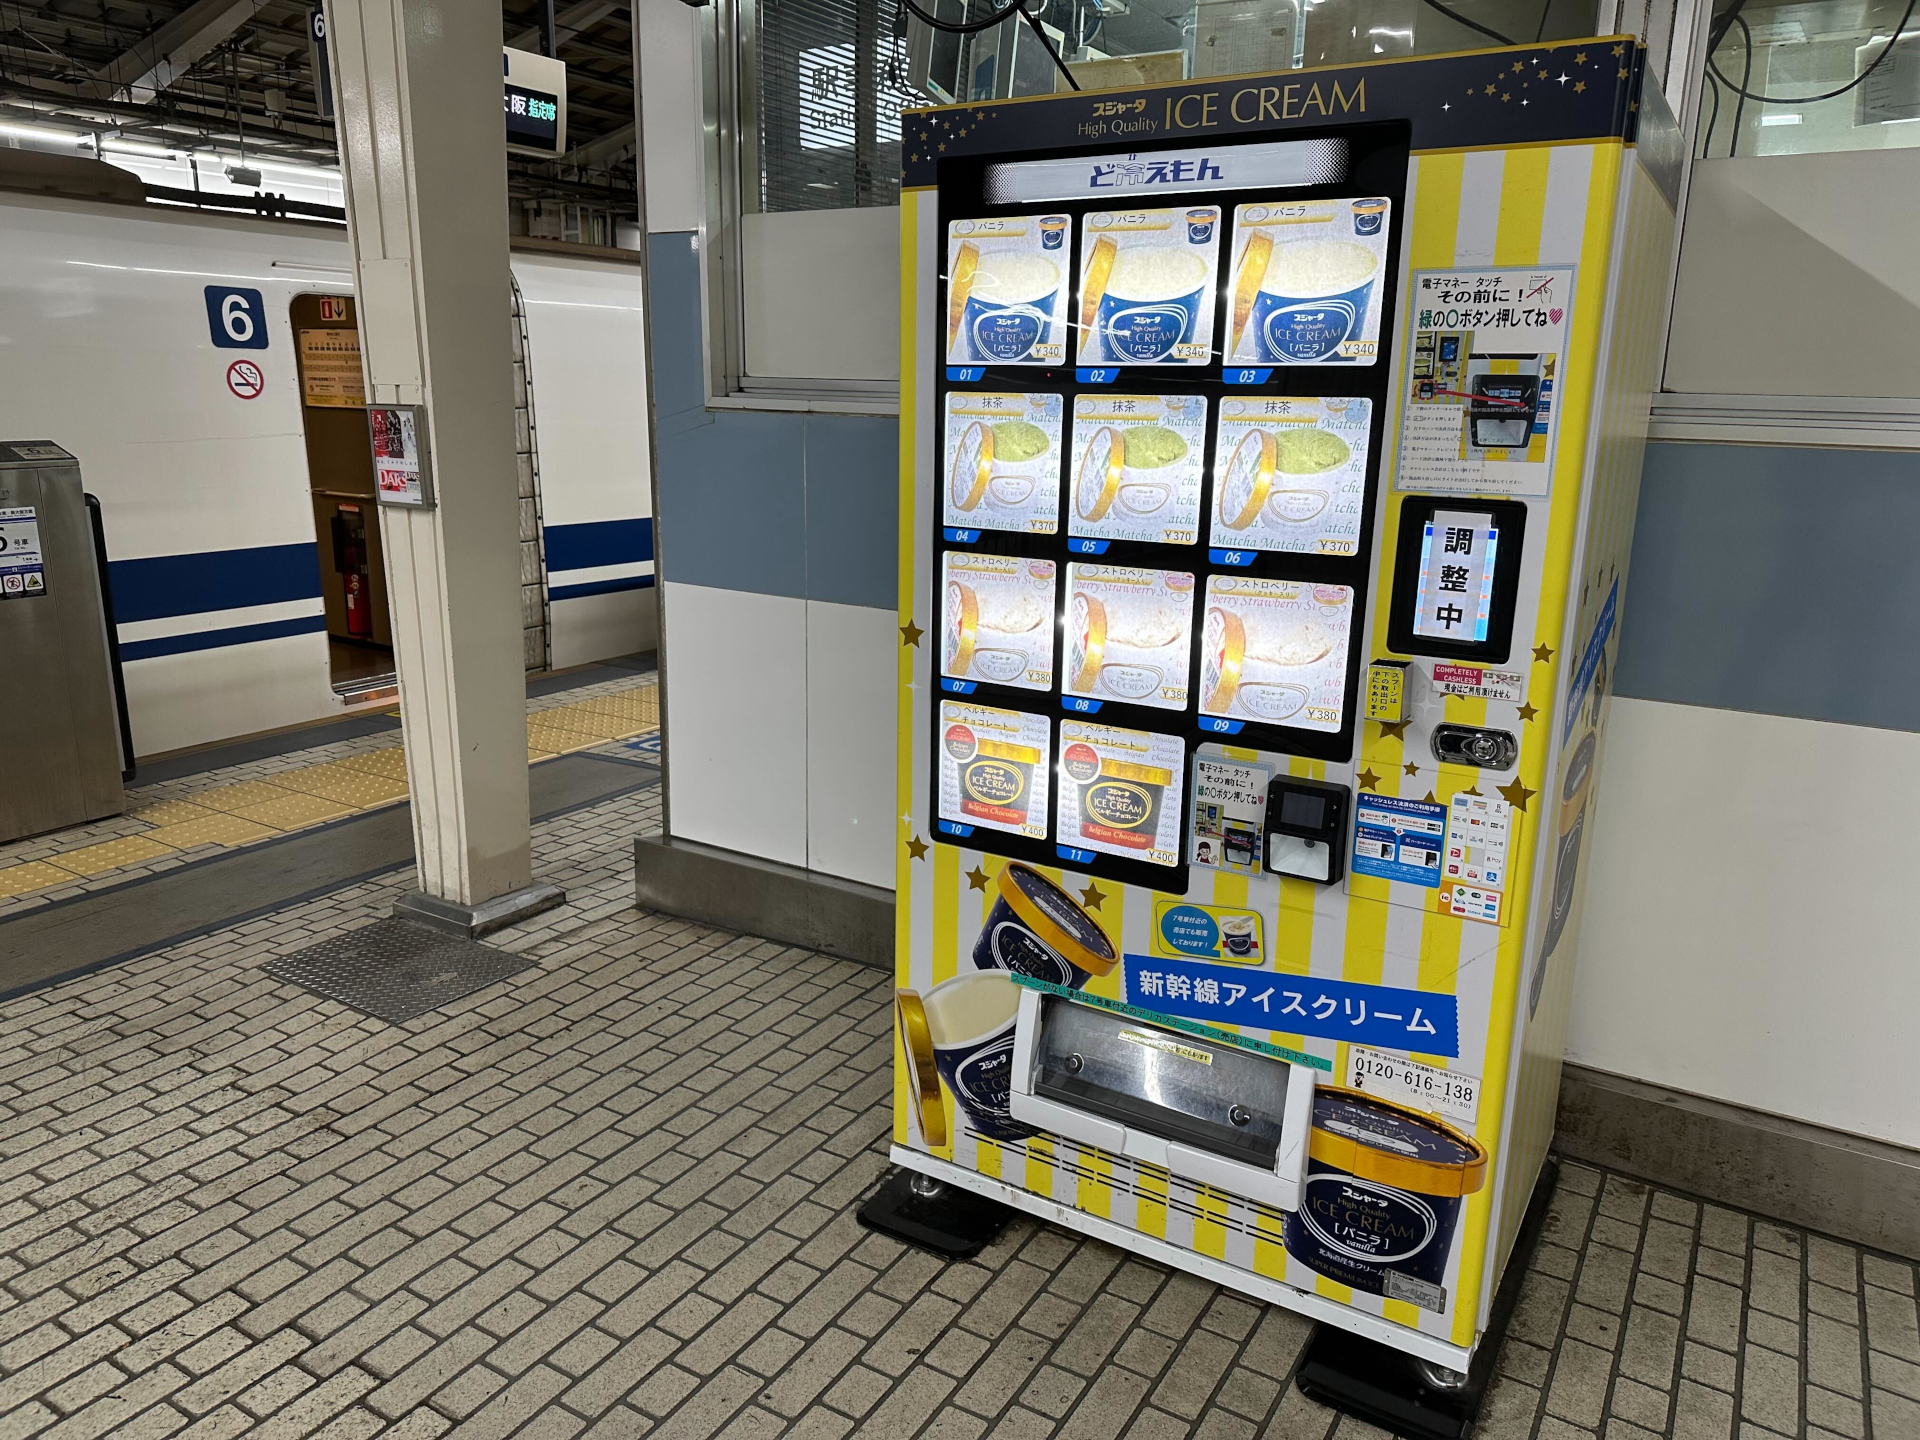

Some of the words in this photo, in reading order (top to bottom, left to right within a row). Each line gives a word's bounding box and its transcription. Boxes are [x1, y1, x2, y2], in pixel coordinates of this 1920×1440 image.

[314, 14, 326, 38] 6
[504, 94, 526, 116] 阪
[528, 98, 556, 122] 指定席
[1078, 123, 1106, 138] High
[1112, 117, 1158, 136] Quality
[1164, 93, 1218, 130] ICE
[1230, 77, 1366, 124] CREAM
[1093, 99, 1146, 116] スジャータ
[1274, 206, 1306, 216] バニラ
[979, 221, 1005, 230] バニラ
[1118, 215, 1147, 224] バニラ
[1422, 278, 1470, 289] 電子マネー
[1476, 276, 1502, 288] タッチ
[222, 294, 254, 342] 6
[996, 318, 1021, 326] スジャータ
[1134, 316, 1161, 324] スジャータ
[1293, 313, 1325, 322] スジャータ
[982, 331, 997, 342] ICE
[998, 331, 1032, 342] CREAM
[1136, 330, 1175, 343] CREAM
[1275, 328, 1292, 340] ICE
[1296, 327, 1341, 342] CREAM
[1035, 346, 1059, 357] ¥340
[1343, 343, 1374, 355] ¥340
[960, 369, 972, 380] 01
[1090, 370, 1105, 382] 02
[1239, 370, 1256, 382] 03
[982, 397, 1003, 409] 抹茶
[1112, 400, 1136, 412] 抹茶
[1265, 401, 1291, 414] 抹茶
[380, 470, 407, 486] DARS
[949, 515, 982, 527] Matcha
[985, 518, 1020, 530] Matcha
[1030, 521, 1054, 531] ¥370
[956, 532, 968, 541] 04
[1072, 526, 1110, 538] Matcha
[1114, 528, 1152, 541] Matcha
[1165, 531, 1191, 541] ¥370
[1082, 541, 1096, 551] 05
[1214, 534, 1257, 548] Matcha
[1260, 537, 1306, 551] Matcha
[1320, 540, 1350, 552] ¥370
[972, 556, 1018, 566] ストロベリー
[1225, 552, 1240, 564] 06
[973, 570, 1021, 583] Strawberry
[1102, 566, 1154, 577] ストロベリー
[1436, 527, 1474, 630] 調整中
[1101, 581, 1156, 595] Strawberry
[1241, 580, 1300, 590] ストロベリー
[1240, 596, 1301, 610] Strawberry
[993, 665, 1020, 673] CREAM
[1436, 666, 1477, 676] COMPLETELY
[1028, 673, 1051, 682] ¥380
[1444, 676, 1476, 684] CASHLESS
[952, 682, 965, 691] 07
[1123, 680, 1153, 690] CREAM
[1390, 672, 1399, 704] スプーンは
[1162, 689, 1188, 699] ¥380
[1370, 671, 1381, 716] 中にもあります
[1380, 672, 1390, 711] 下の取出口の
[964, 707, 995, 715] ベルギー
[1075, 700, 1089, 710] 08
[1263, 700, 1297, 710] CREAM
[1308, 709, 1337, 721] ¥380
[963, 717, 1008, 730] チョコレート
[1086, 725, 1120, 734] ベルギー
[1213, 721, 1229, 731] 09
[1084, 735, 1135, 749] チョコレート
[1198, 762, 1229, 775] 電子マネー
[1234, 768, 1251, 778] タッチ
[972, 776, 984, 785] ICE
[986, 778, 1015, 791] CREAM
[968, 802, 989, 812] Belgian
[990, 806, 1020, 819] Chocolate
[1094, 797, 1107, 808] ICE
[1110, 800, 1142, 814] CREAM
[951, 825, 962, 834] 10
[1022, 826, 1043, 837] ¥400
[1089, 826, 1112, 837] Belgian
[1113, 830, 1146, 842] Chocolate
[1071, 850, 1082, 860] 11
[1149, 850, 1173, 862] ¥400
[1173, 915, 1208, 924] 7号車付近の
[1173, 927, 1208, 937] 売店でも販売
[1001, 934, 1017, 953] ICE
[1023, 937, 1048, 960] スジャータ
[1139, 970, 1437, 1035] 新幹線アイスクリーム
[978, 1054, 1006, 1070] スジャータ
[1356, 1057, 1473, 1102] 0120-616-138
[969, 1080, 991, 1093] ICE
[1342, 1186, 1388, 1207] スジャータ
[1338, 1197, 1357, 1210] High
[1360, 1205, 1391, 1220] Quality
[1313, 1196, 1339, 1219] ICE
[1345, 1211, 1414, 1239] CREAM
[1346, 1239, 1376, 1253] vanilla
